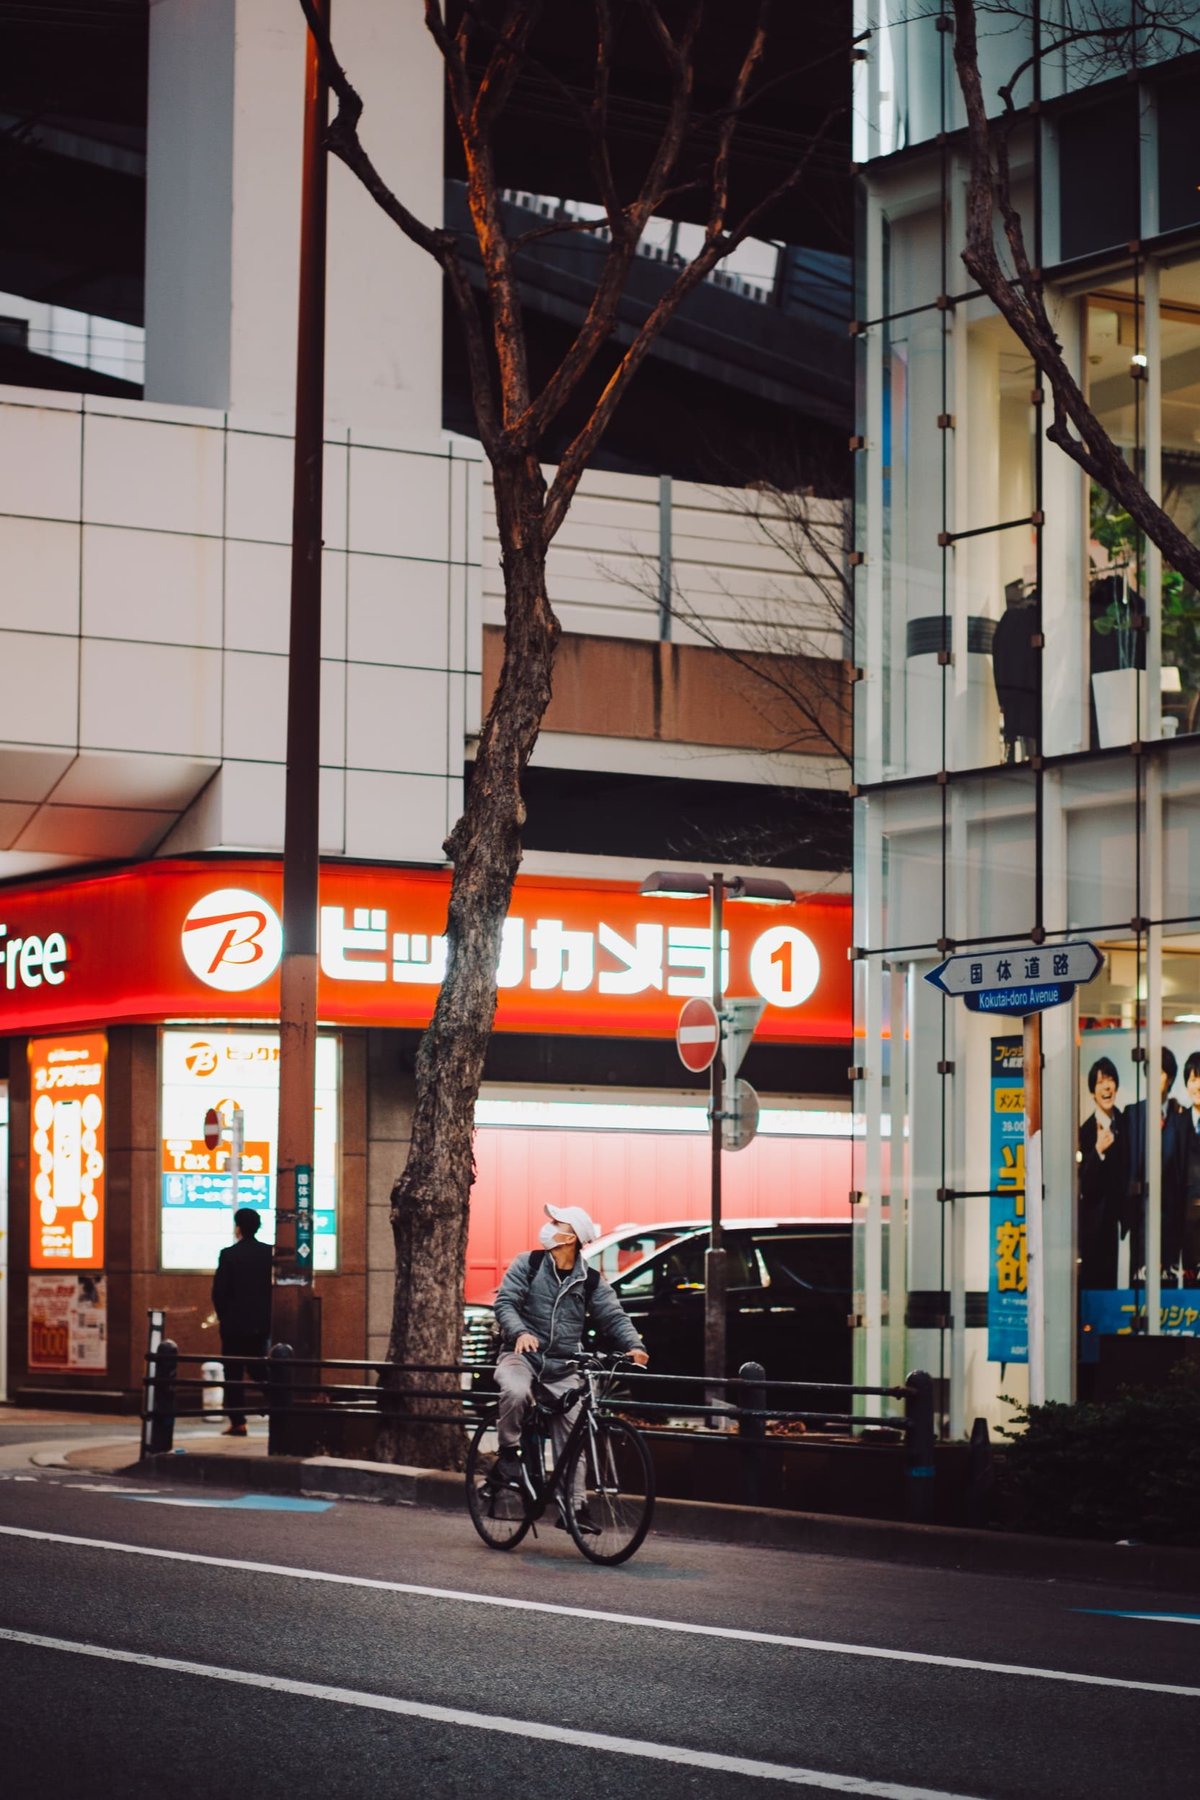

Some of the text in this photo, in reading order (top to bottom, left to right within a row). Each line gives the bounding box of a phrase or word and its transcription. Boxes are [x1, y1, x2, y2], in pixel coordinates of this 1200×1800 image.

[970, 953, 1069, 985] 国体道路
[979, 988, 1059, 1009] Kokutai-doro Avenue
[999, 1094, 1025, 1109] メンズ
[170, 1150, 264, 1172] Tax Fee
